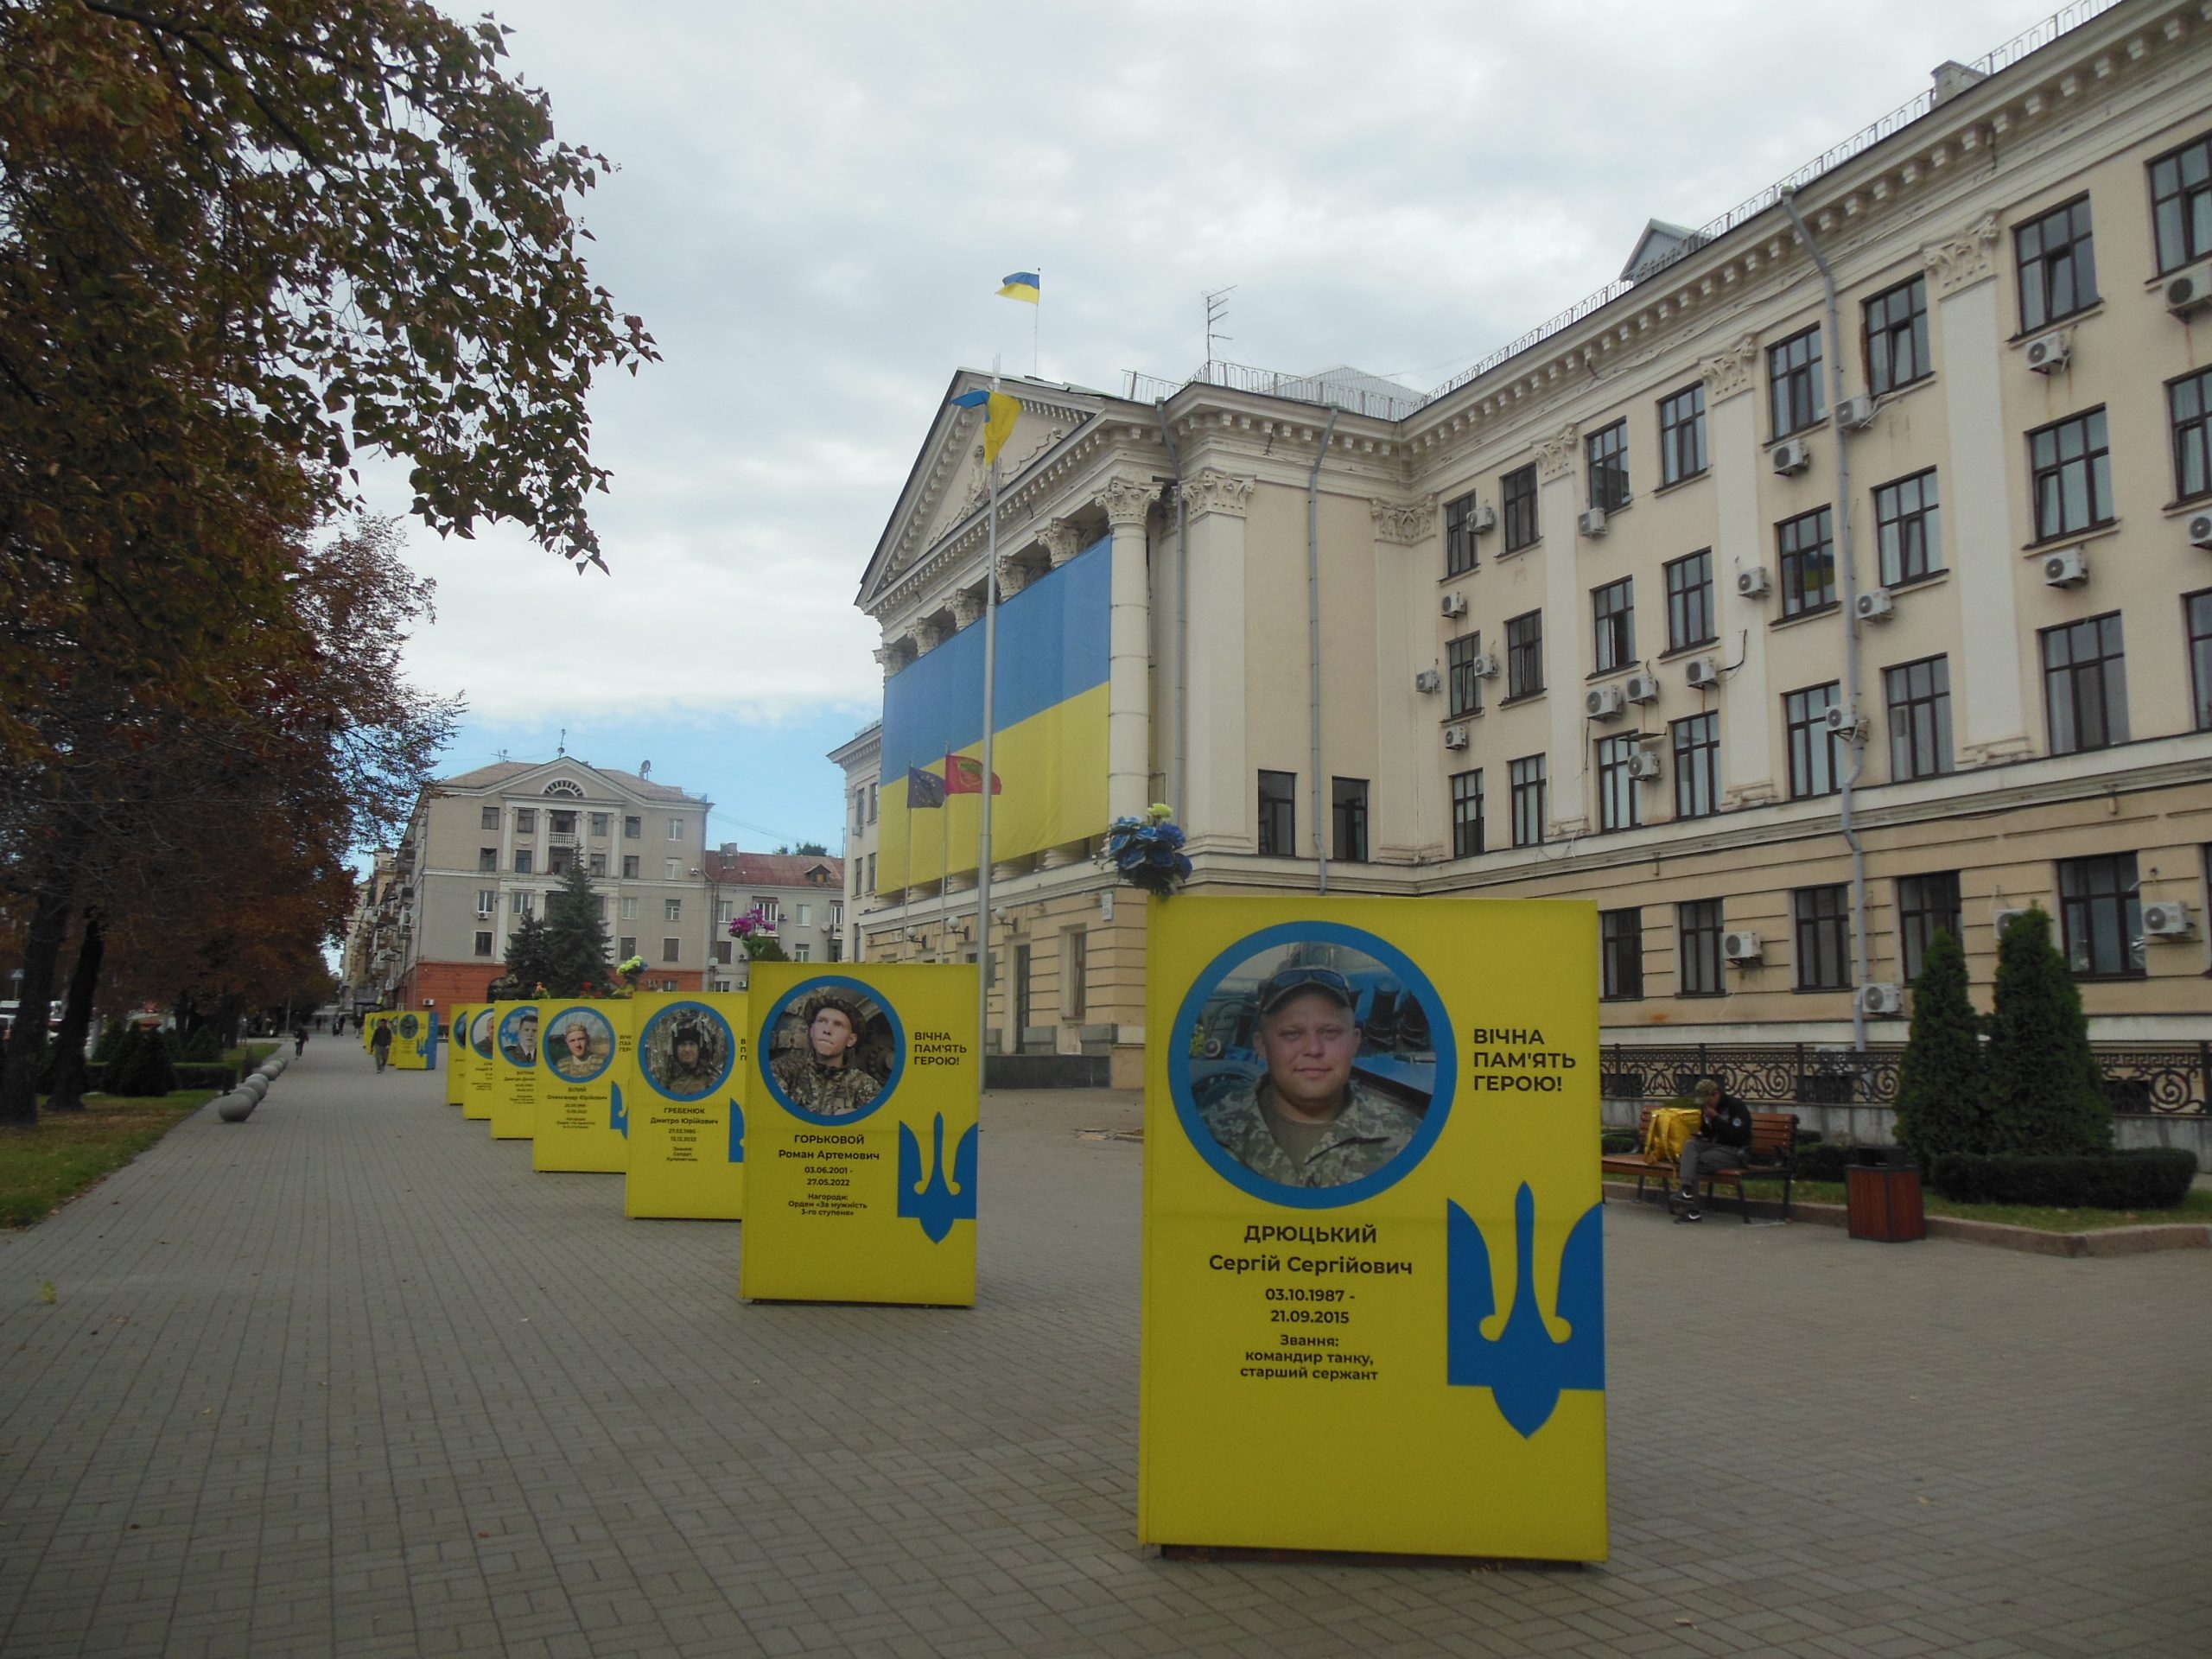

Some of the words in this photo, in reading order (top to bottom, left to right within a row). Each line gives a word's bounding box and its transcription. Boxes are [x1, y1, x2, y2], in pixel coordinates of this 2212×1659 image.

[914, 1031, 951, 1041] ВІЧНА
[1473, 1028, 1545, 1046] ВІЧНА
[914, 1044, 968, 1053] ПАМ'ЯТЬ
[913, 1056, 960, 1065] ГЕРОЮ!
[1473, 1052, 1576, 1069] ПАМ'ЯТЬ
[1473, 1075, 1562, 1092] ГЕРОЮ!
[650, 1116, 680, 1125] Дмитро
[681, 1117, 719, 1126] Юрійович
[794, 1134, 865, 1145] ГОРЬКОВОЙ
[779, 1149, 815, 1159] Роман
[817, 1149, 880, 1161] Артемович
[804, 1166, 848, 1174] 03.06.2001
[806, 1178, 850, 1186] 27.05.2022
[1243, 1224, 1376, 1245] ДРЮЦЬКИЙ
[1209, 1254, 1281, 1275] Сергій
[1287, 1255, 1413, 1277] Сергійович
[1265, 1287, 1345, 1302] 03.10.1987
[1270, 1309, 1350, 1325] 21.09.2015
[1280, 1334, 1339, 1347] Звання:
[1245, 1351, 1323, 1365] командир
[1326, 1353, 1374, 1367] танку,
[1240, 1366, 1308, 1380] старший
[1312, 1370, 1379, 1382] сержант
